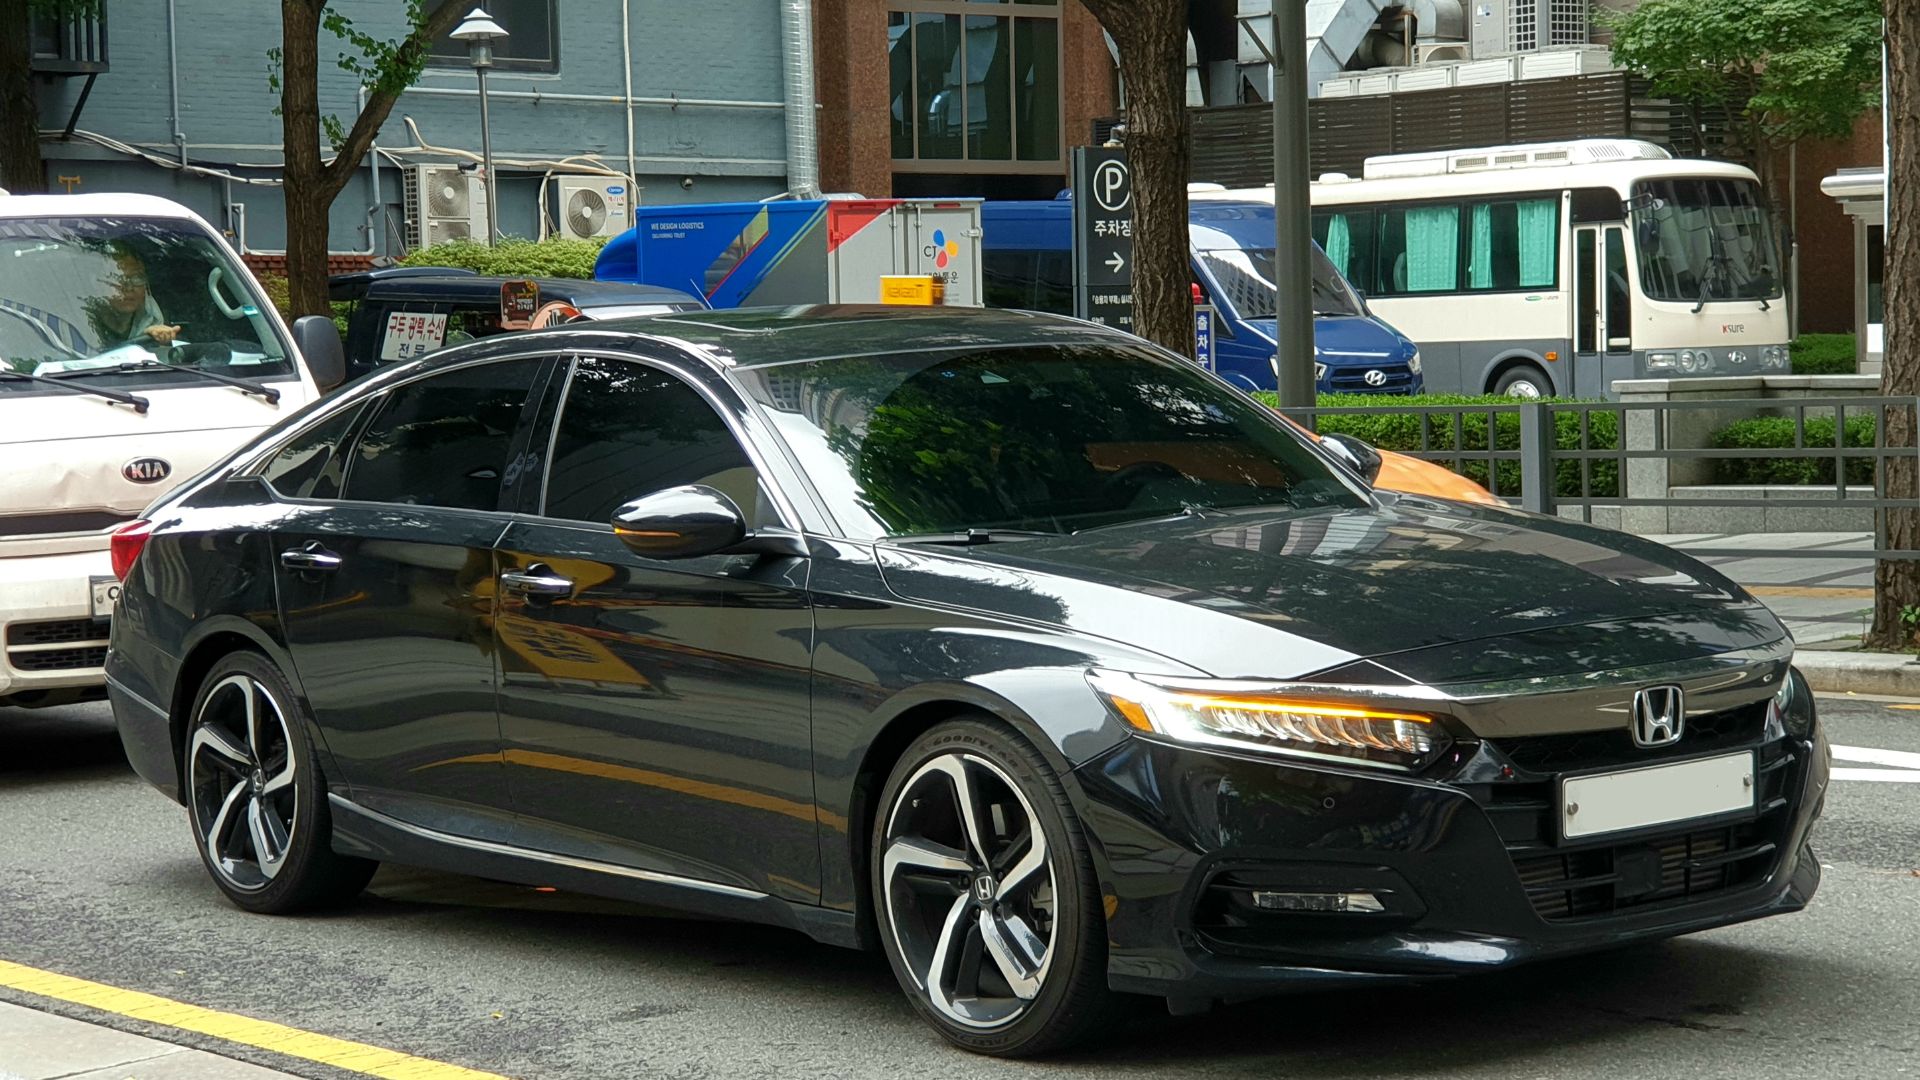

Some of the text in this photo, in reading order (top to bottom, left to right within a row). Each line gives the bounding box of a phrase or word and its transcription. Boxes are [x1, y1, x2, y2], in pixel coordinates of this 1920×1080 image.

[1105, 167, 1123, 204] P
[1094, 219, 1132, 237] 주차장
[923, 245, 937, 260] CJ
[389, 316, 407, 339] 구두
[131, 462, 165, 479] KIA
